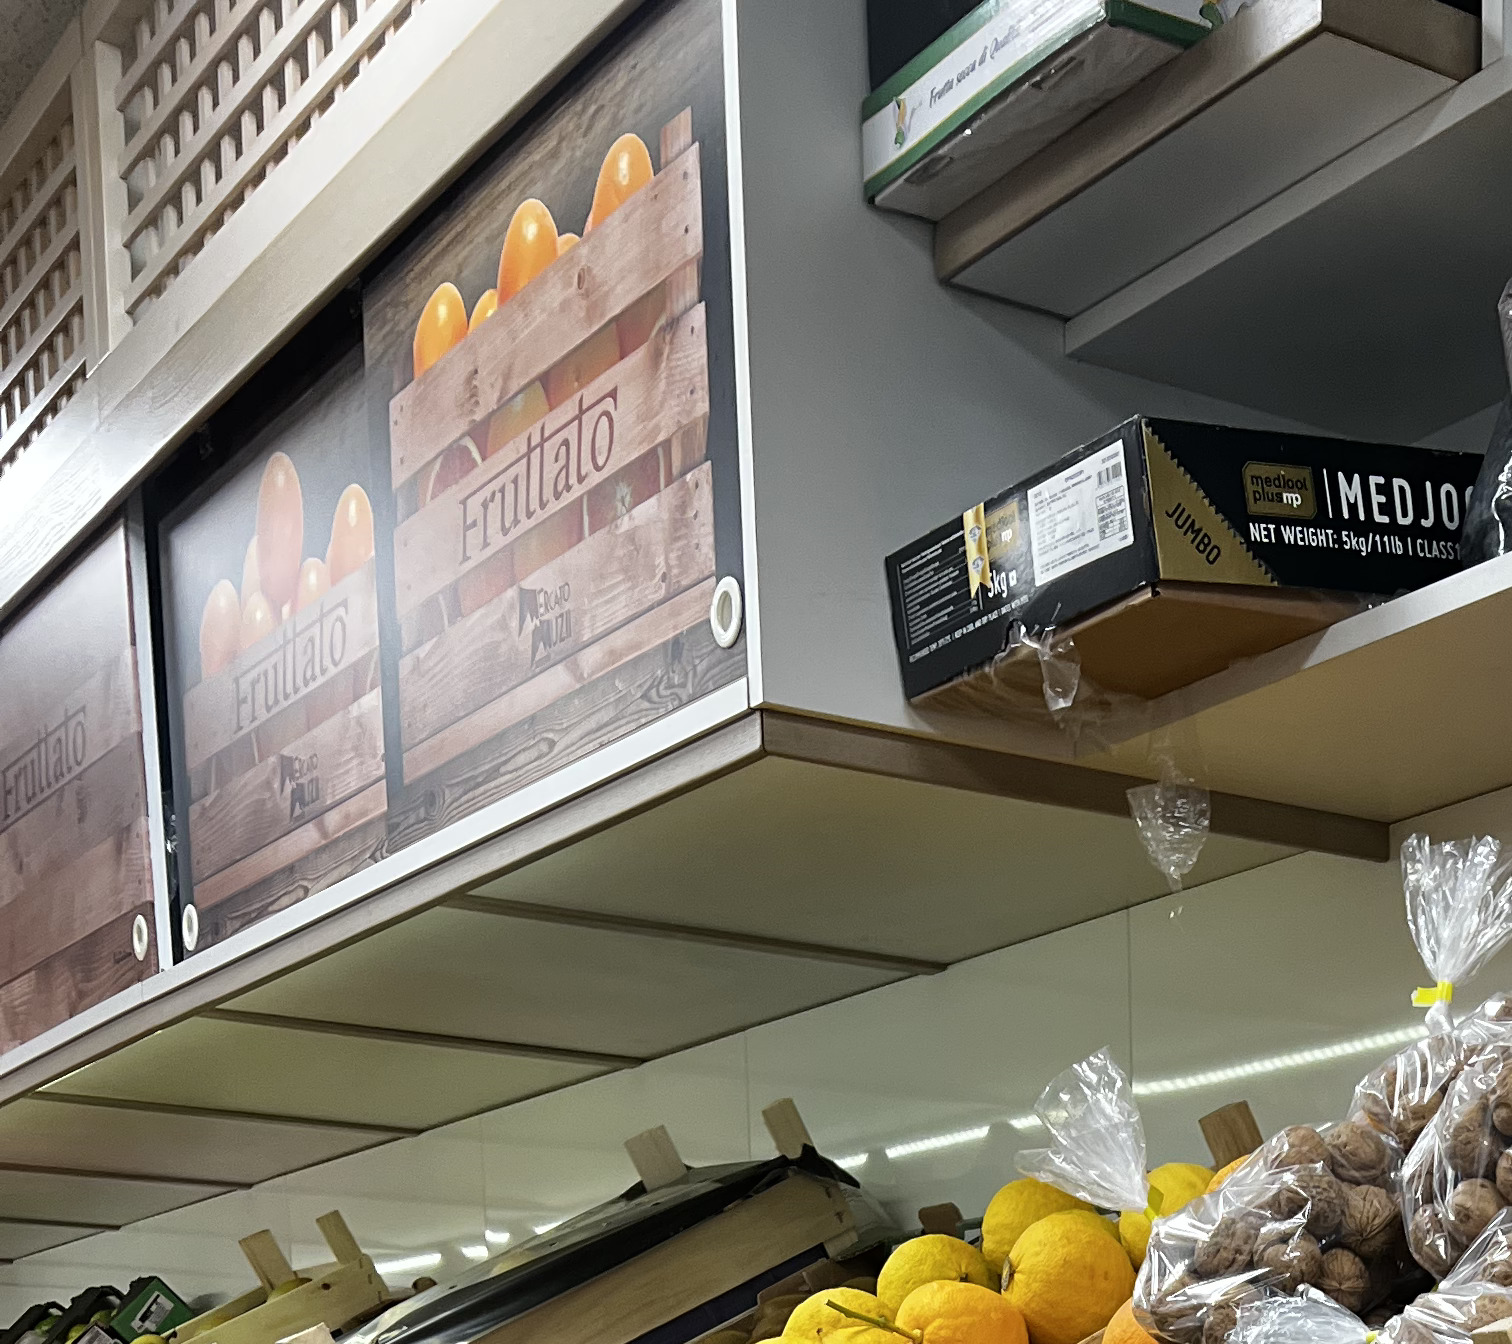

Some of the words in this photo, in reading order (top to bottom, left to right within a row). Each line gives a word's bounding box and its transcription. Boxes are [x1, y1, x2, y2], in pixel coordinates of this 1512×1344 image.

[459, 385, 618, 566] Fruttato
[1337, 471, 1474, 531] MEDJO
[1165, 503, 1222, 566] JUMBO
[1250, 522, 1276, 543] NET
[1281, 525, 1339, 549] WEIGHT:
[1342, 532, 1404, 556] 5kg/11lb
[233, 598, 349, 735] Fruttato
[1, 703, 87, 822] Fruttato
